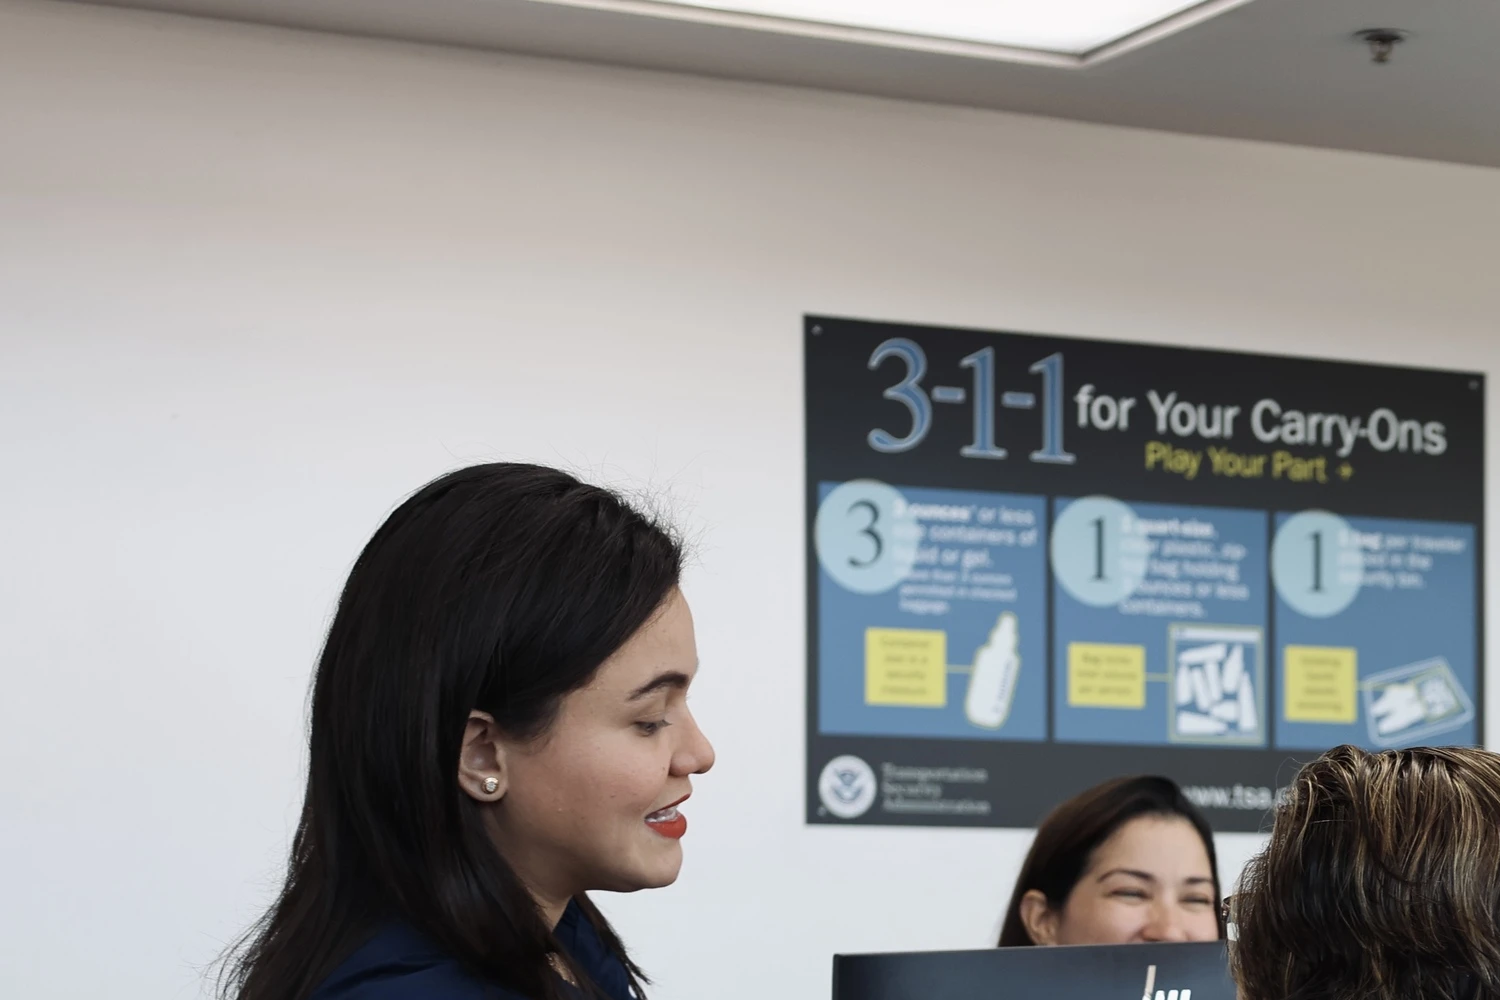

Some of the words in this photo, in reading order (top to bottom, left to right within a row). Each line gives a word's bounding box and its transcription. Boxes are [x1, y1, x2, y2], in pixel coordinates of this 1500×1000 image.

[867, 337, 1076, 465] 3-1-1
[1073, 384, 1136, 431] for
[1147, 391, 1240, 438] Your
[1251, 399, 1448, 457] Carry-Ons
[1146, 442, 1201, 480] Play
[1208, 446, 1267, 477] Your
[1271, 451, 1328, 484] Part
[847, 498, 883, 568] 3
[1090, 515, 1110, 581] 1
[1308, 530, 1325, 594] 1
